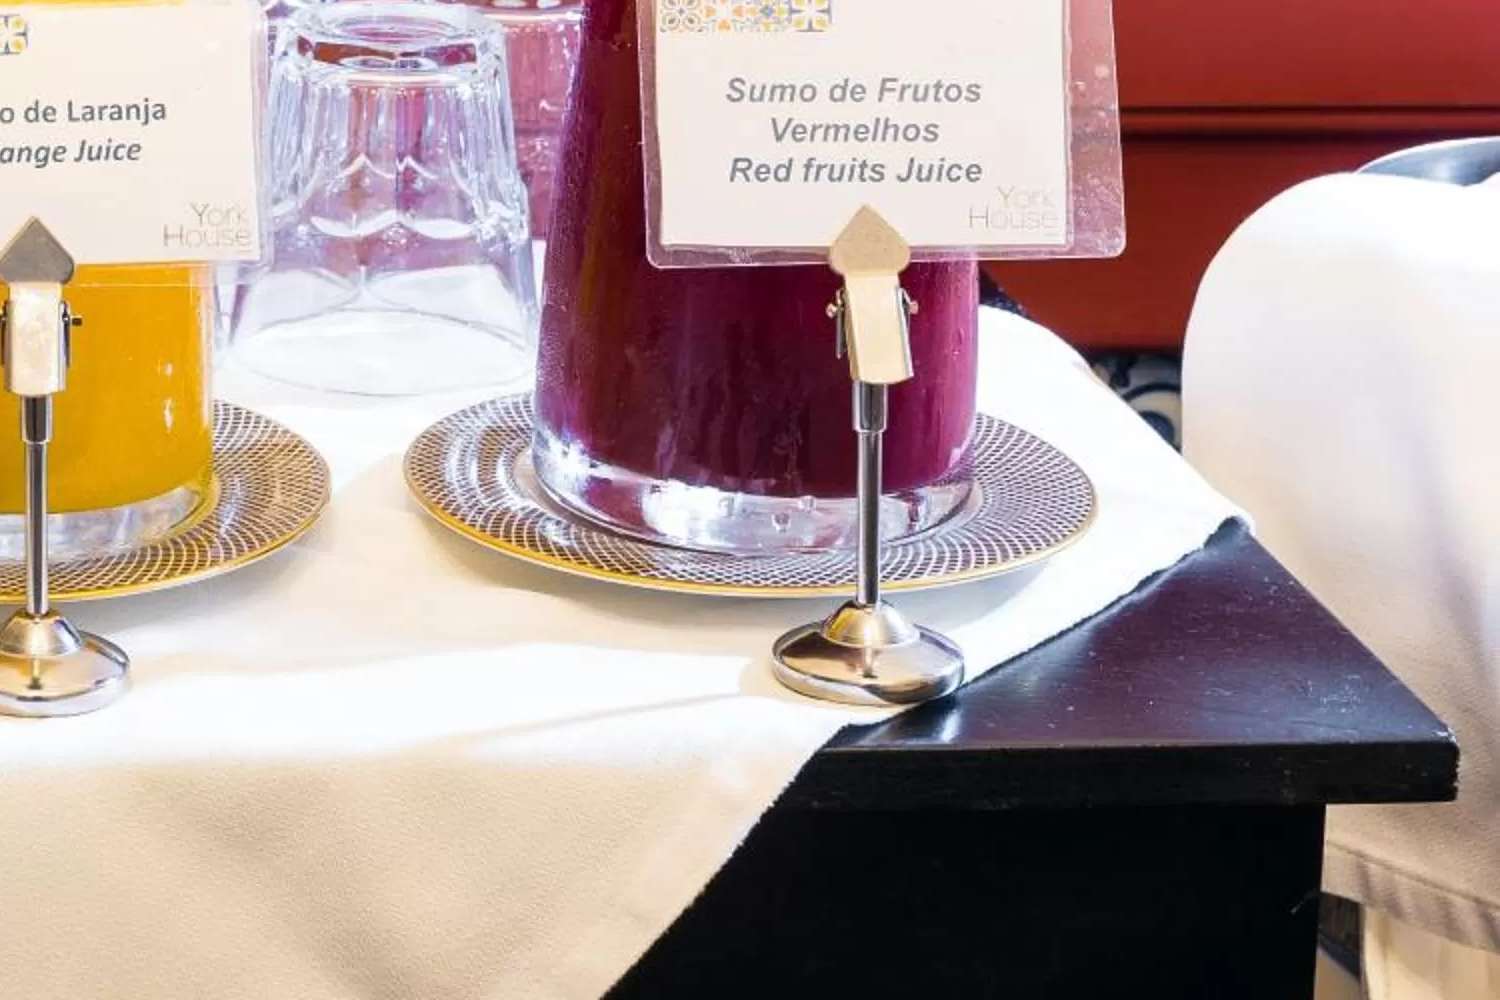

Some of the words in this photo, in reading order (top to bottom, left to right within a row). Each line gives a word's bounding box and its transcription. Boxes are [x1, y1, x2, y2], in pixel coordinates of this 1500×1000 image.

[725, 76, 818, 104] Sumo
[828, 77, 867, 104] de
[877, 76, 983, 104] Frutos
[22, 98, 58, 124] de
[66, 96, 167, 127] Laranja
[770, 116, 940, 144] Vermelhos
[72, 137, 143, 164] Juice
[729, 156, 795, 184] Red
[802, 156, 887, 184] fruits
[895, 156, 983, 184] Juice
[996, 184, 1056, 209] York
[189, 201, 249, 228] York
[968, 204, 1060, 230] House
[162, 222, 253, 248] House
